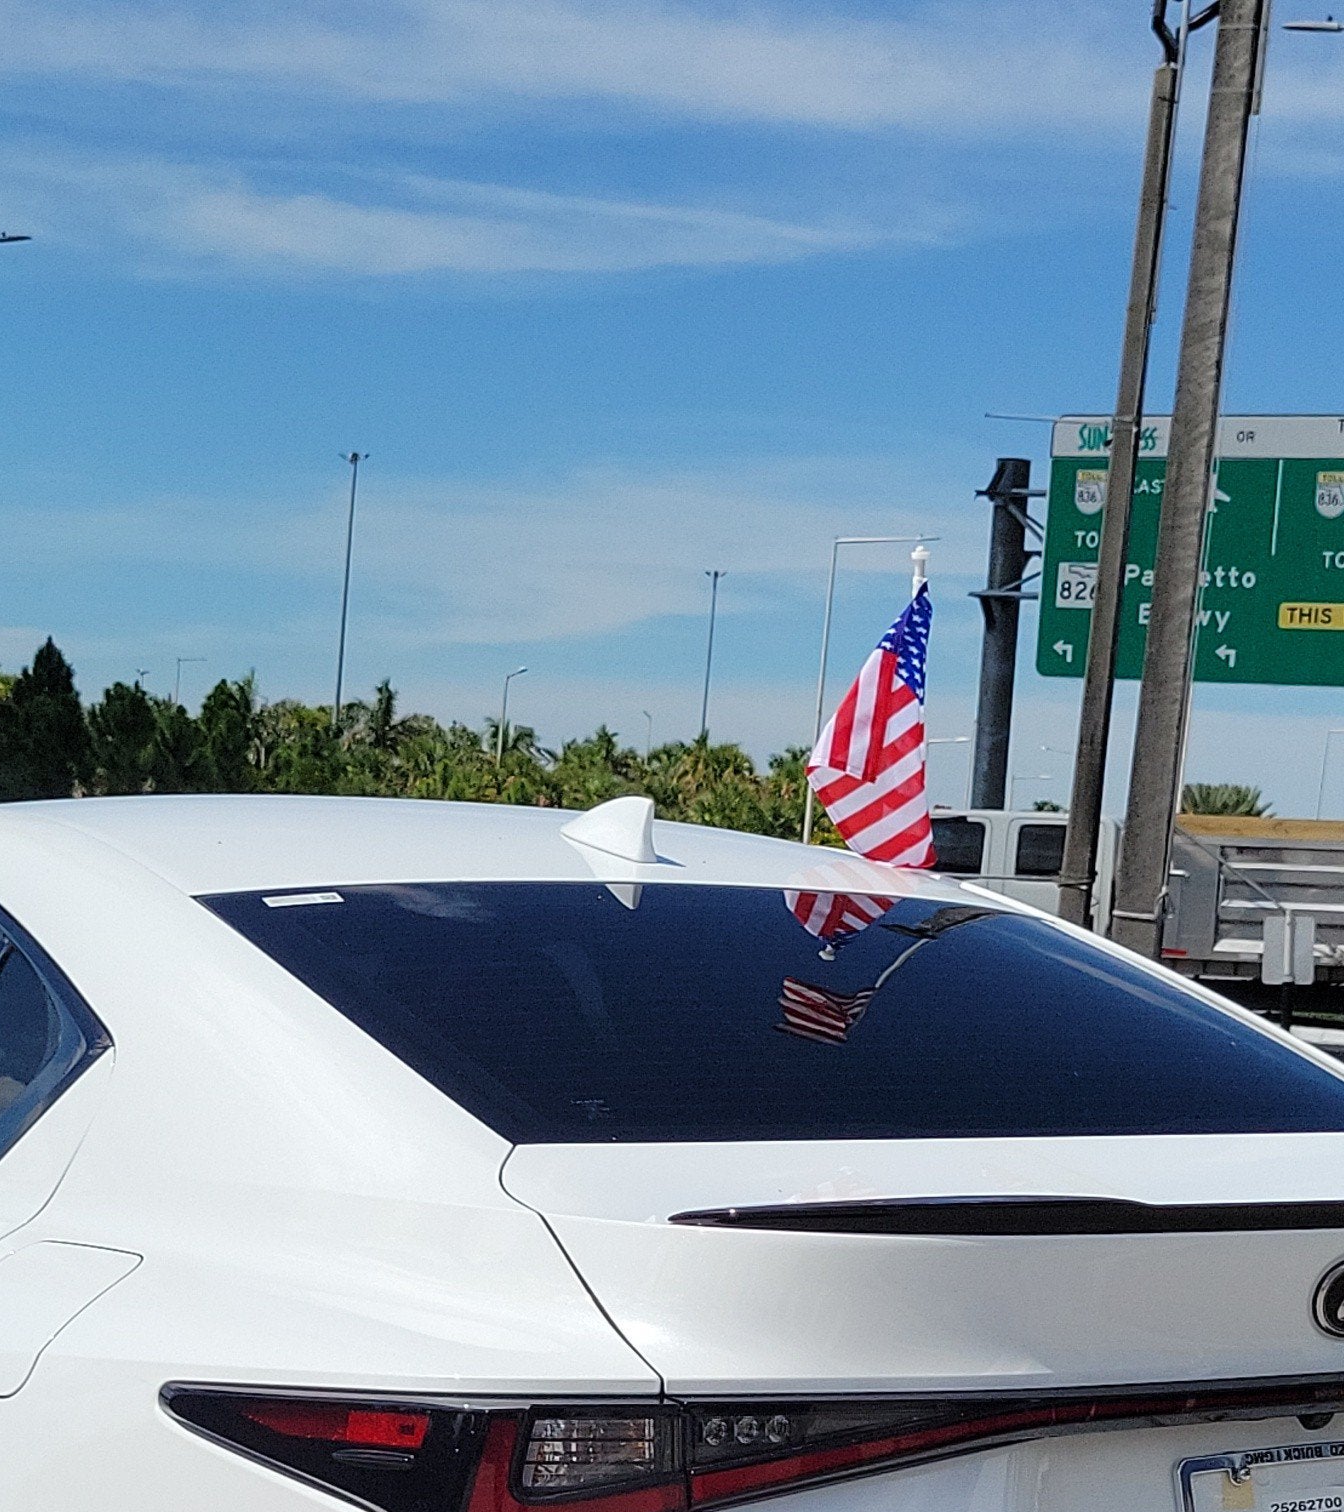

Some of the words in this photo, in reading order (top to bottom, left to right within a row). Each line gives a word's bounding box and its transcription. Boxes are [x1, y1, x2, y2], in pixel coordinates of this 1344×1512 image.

[1236, 430, 1256, 443] OR
[1074, 530, 1099, 549] TO
[1124, 563, 1257, 589] Paetto
[1138, 602, 1231, 634] Ewy
[1286, 607, 1333, 624] THIS
[1284, 1446, 1324, 1461] BUICK
